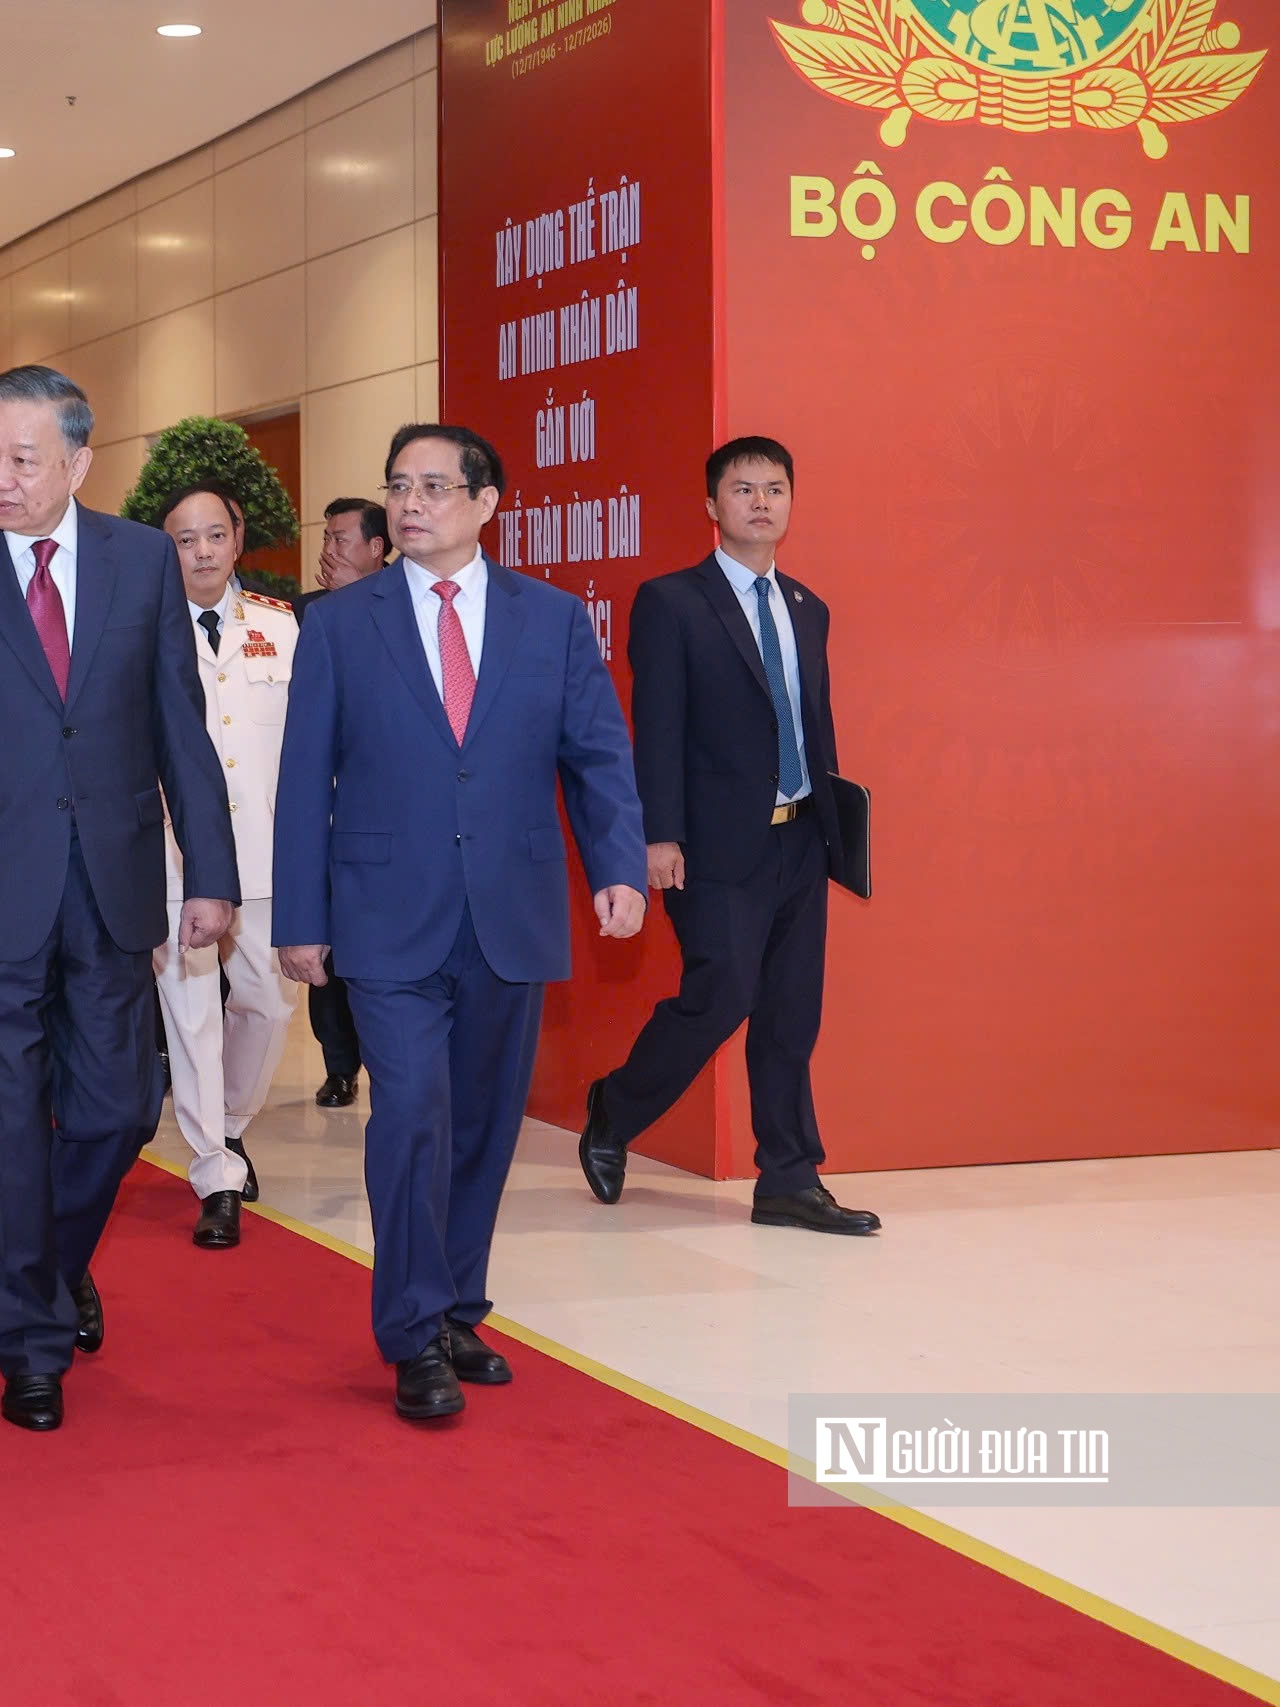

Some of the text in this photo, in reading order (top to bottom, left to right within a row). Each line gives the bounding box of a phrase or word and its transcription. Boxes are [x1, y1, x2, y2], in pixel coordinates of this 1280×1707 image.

[485, 33, 504, 68] LỰC
[506, 17, 538, 56] LƯỢNG
[540, 8, 555, 39] AN
[557, 0, 584, 30] NINH
[511, 43, 556, 80] (12/7/1946
[564, 13, 612, 53] 12/7/2026)
[496, 175, 640, 289] XÂY DỰNG THẾ TRẬN
[790, 160, 1250, 260] BỘ CÔNG AN
[498, 279, 638, 381] AN NINH NHÂN DÂN
[535, 387, 596, 469] GẮN VỚI
[498, 484, 640, 579] THẾ TRẬN LÒNG DÂN
